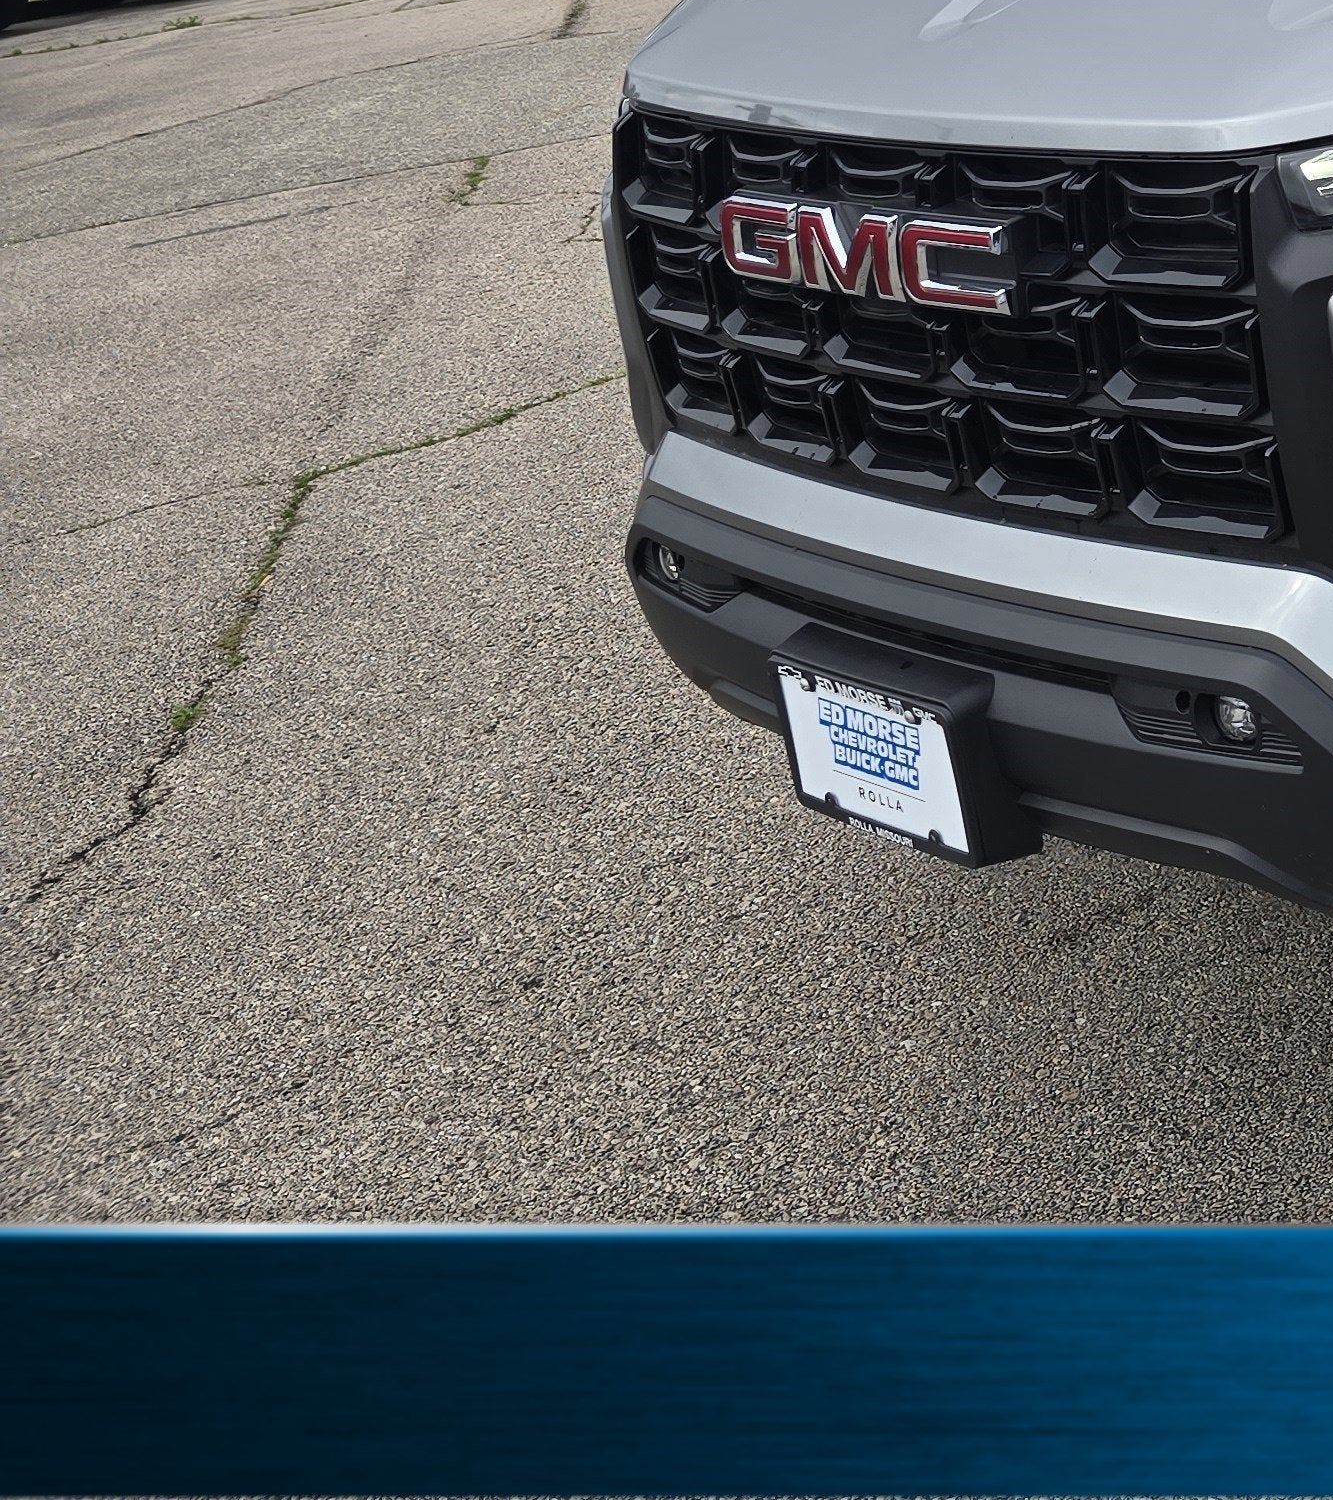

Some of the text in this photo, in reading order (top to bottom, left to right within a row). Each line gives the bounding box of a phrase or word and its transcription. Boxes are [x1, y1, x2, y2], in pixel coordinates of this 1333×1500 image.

[720, 196, 1012, 316] GMC
[815, 675, 835, 692] ED
[835, 682, 889, 711] MORSE
[818, 698, 919, 751] ED MORSE
[858, 787, 904, 813] ROLLA
